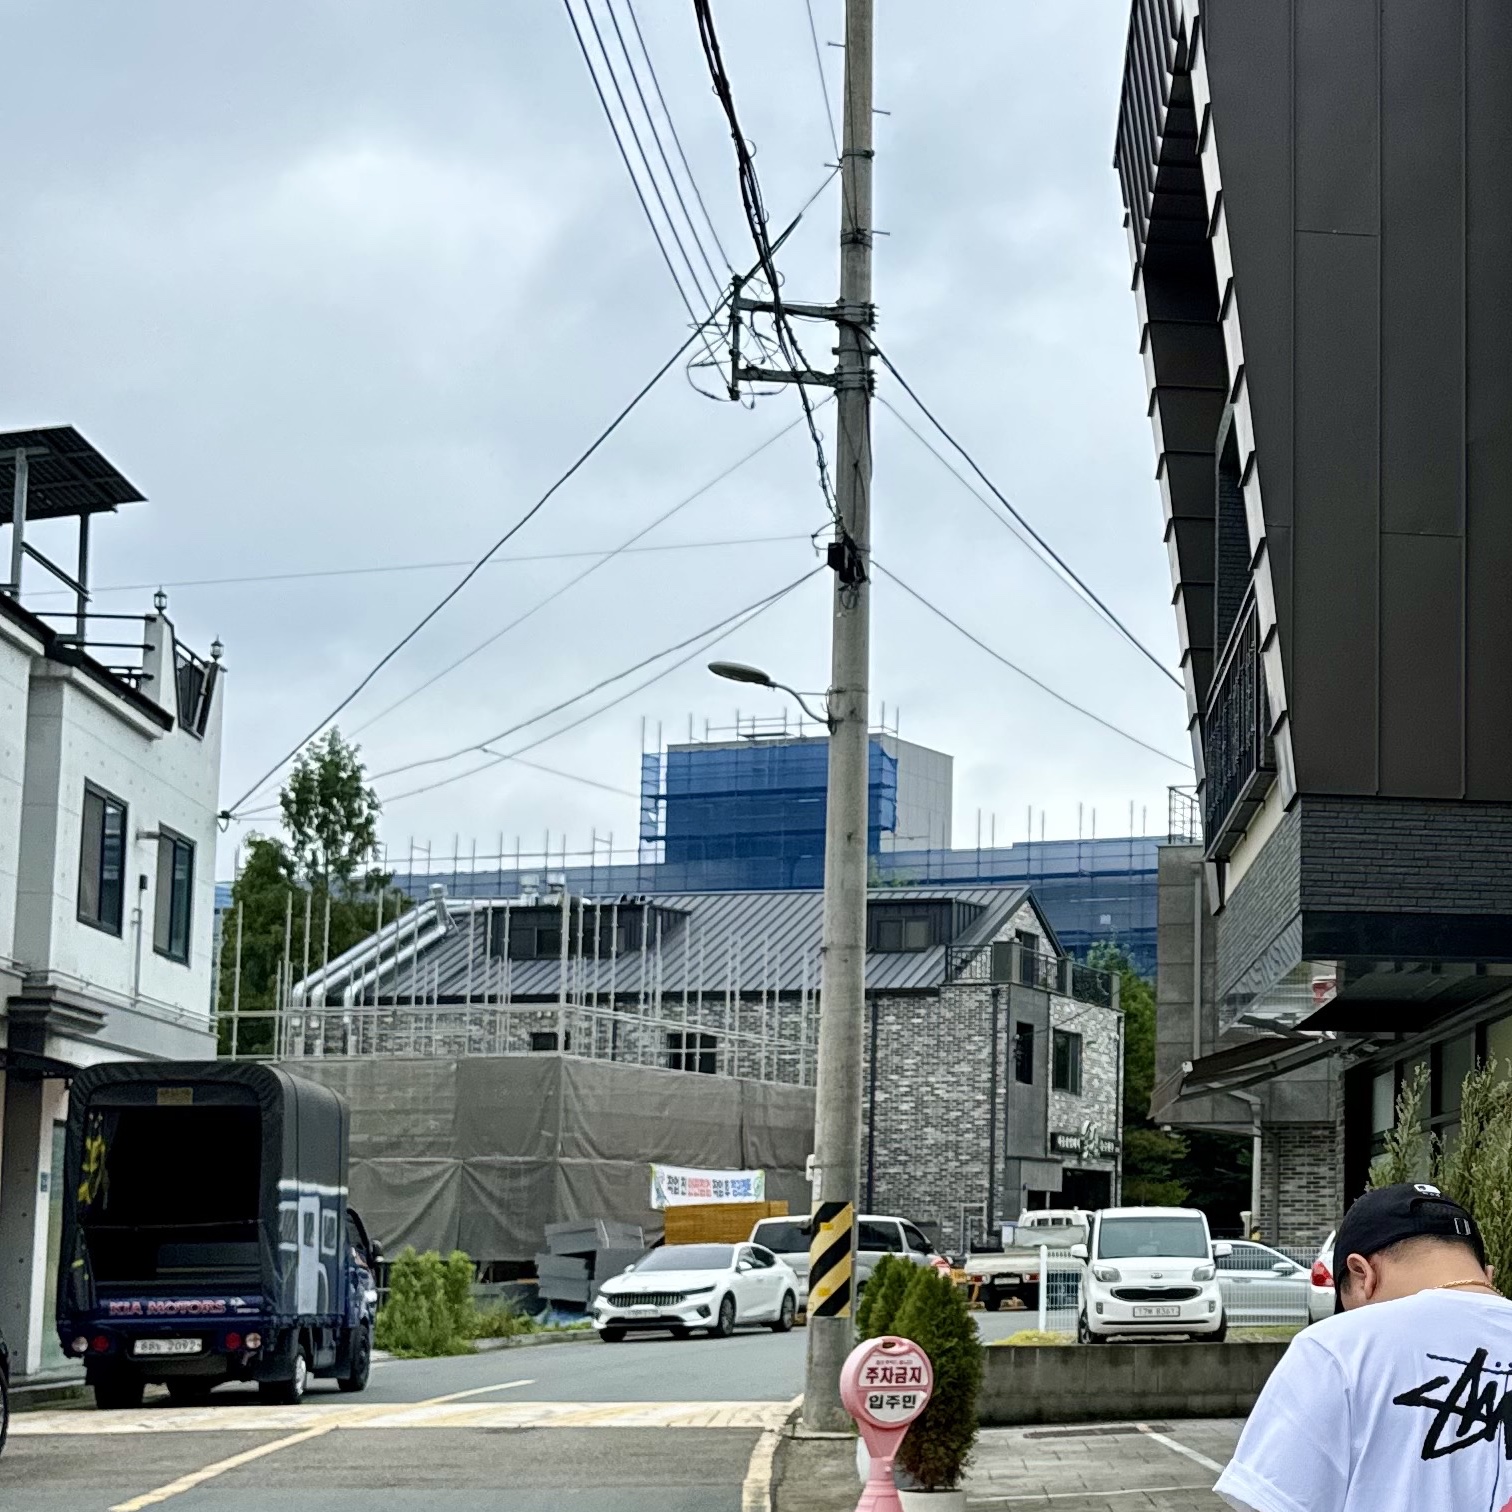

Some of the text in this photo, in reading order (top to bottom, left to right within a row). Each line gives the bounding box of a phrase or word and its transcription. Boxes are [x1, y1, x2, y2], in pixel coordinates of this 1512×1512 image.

[109, 1299, 227, 1316] KIA MOTORS
[866, 1366, 922, 1384] 주차금지
[869, 1394, 916, 1410] 입주민
